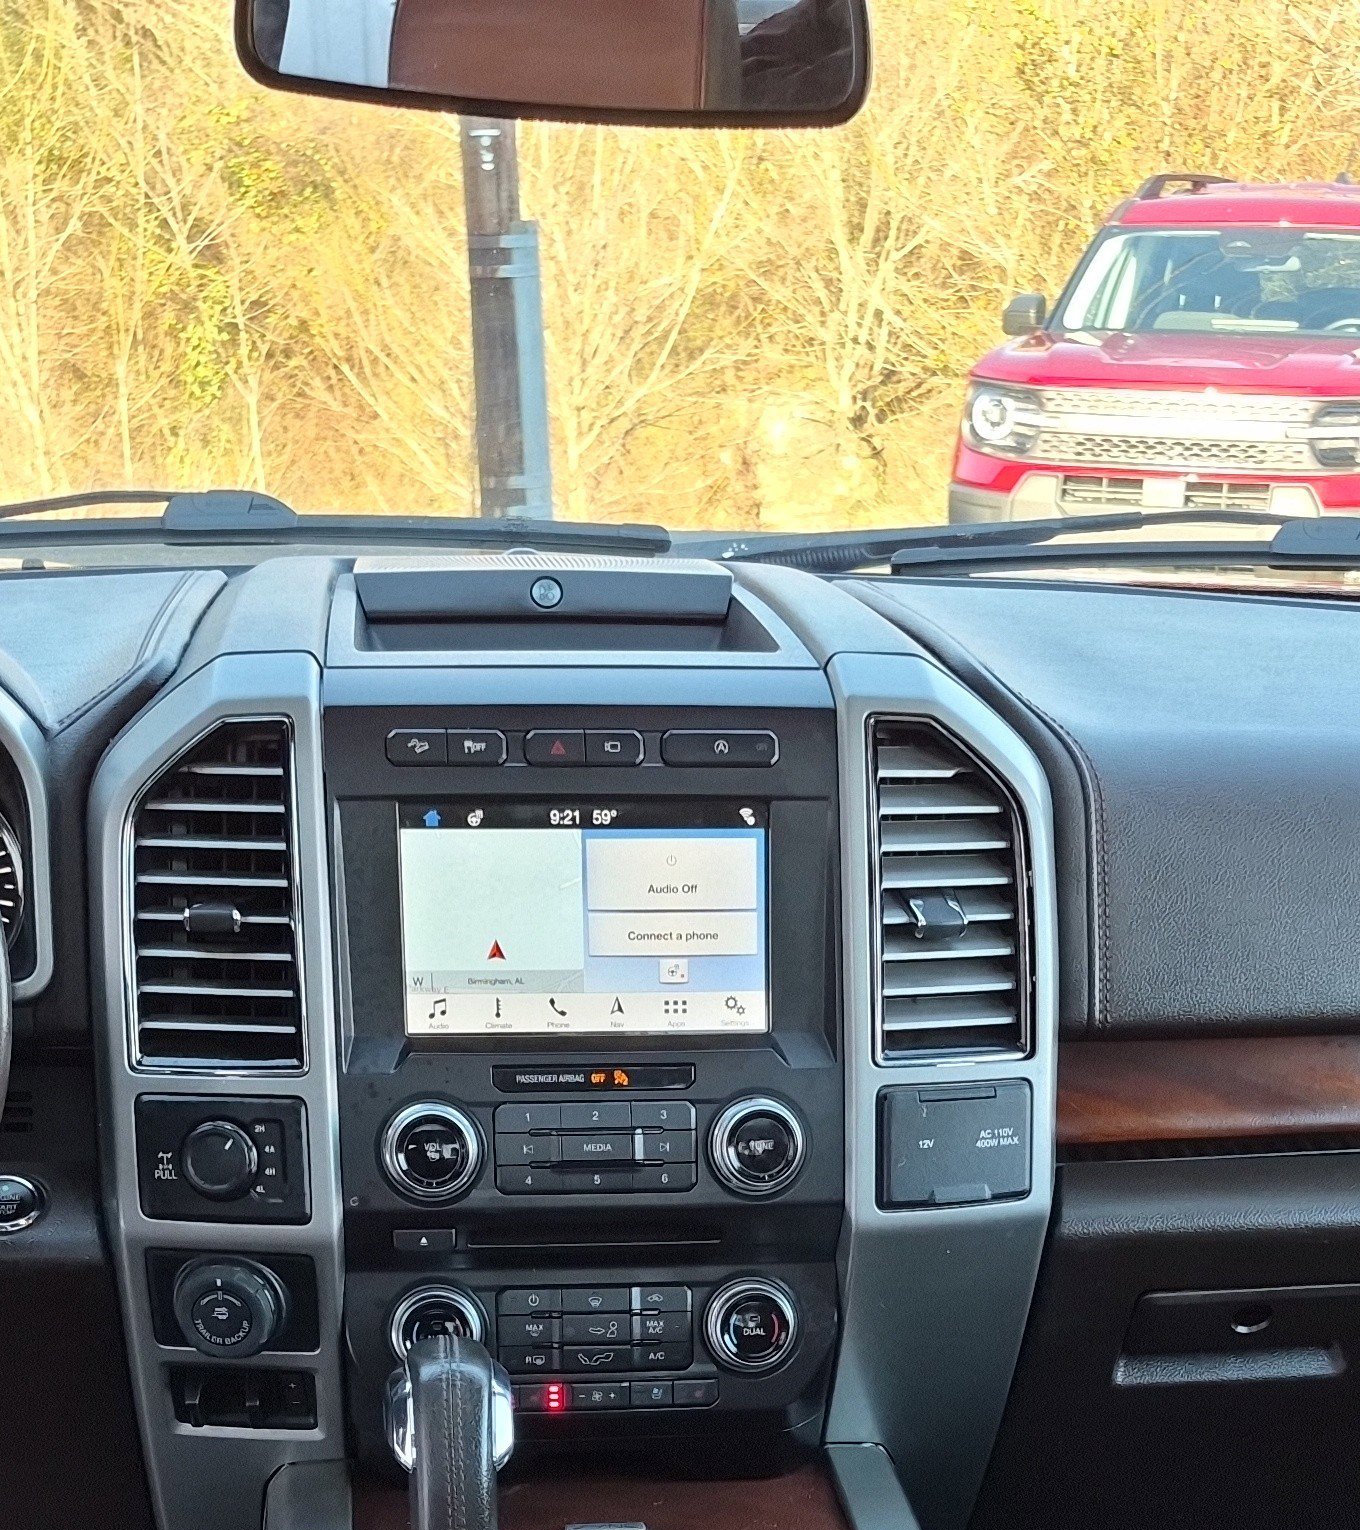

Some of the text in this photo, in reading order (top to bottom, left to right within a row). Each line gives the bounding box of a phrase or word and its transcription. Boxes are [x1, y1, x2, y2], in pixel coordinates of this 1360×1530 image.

[550, 810, 580, 825] 9:21
[648, 883, 698, 894] Audio Off
[628, 931, 719, 943] Connect a phone
[412, 976, 425, 986] W
[515, 978, 526, 986] AL
[428, 1022, 450, 1030] Audio
[485, 1022, 513, 1030] Climate
[546, 1021, 570, 1030] Phone
[610, 1021, 625, 1029] Nav
[720, 1020, 750, 1029] Settings
[516, 1074, 606, 1084] PASSENGER AIRBAG OFF
[592, 1110, 599, 1121] 2
[660, 1110, 668, 1120] 3
[254, 1124, 266, 1134] 2H
[980, 1127, 1014, 1139] AC 110V
[424, 1142, 442, 1152] VOL
[918, 1139, 935, 1148] 12V
[976, 1136, 1020, 1148] 400W MAX
[264, 1144, 276, 1154] 4A
[583, 1143, 613, 1152] MEDIA
[154, 1168, 178, 1180] PULL
[264, 1167, 276, 1176] 4H
[525, 1176, 532, 1185] 4
[594, 1174, 601, 1185] 5
[661, 1173, 668, 1184] 6
[255, 1185, 266, 1194] 4L
[525, 1323, 544, 1332] MAX
[646, 1320, 664, 1328] MAX
[194, 1319, 250, 1344] TRAILER BACKUP
[648, 1326, 664, 1334] A/C
[742, 1327, 766, 1337] DUAL
[648, 1351, 666, 1360] A/C
